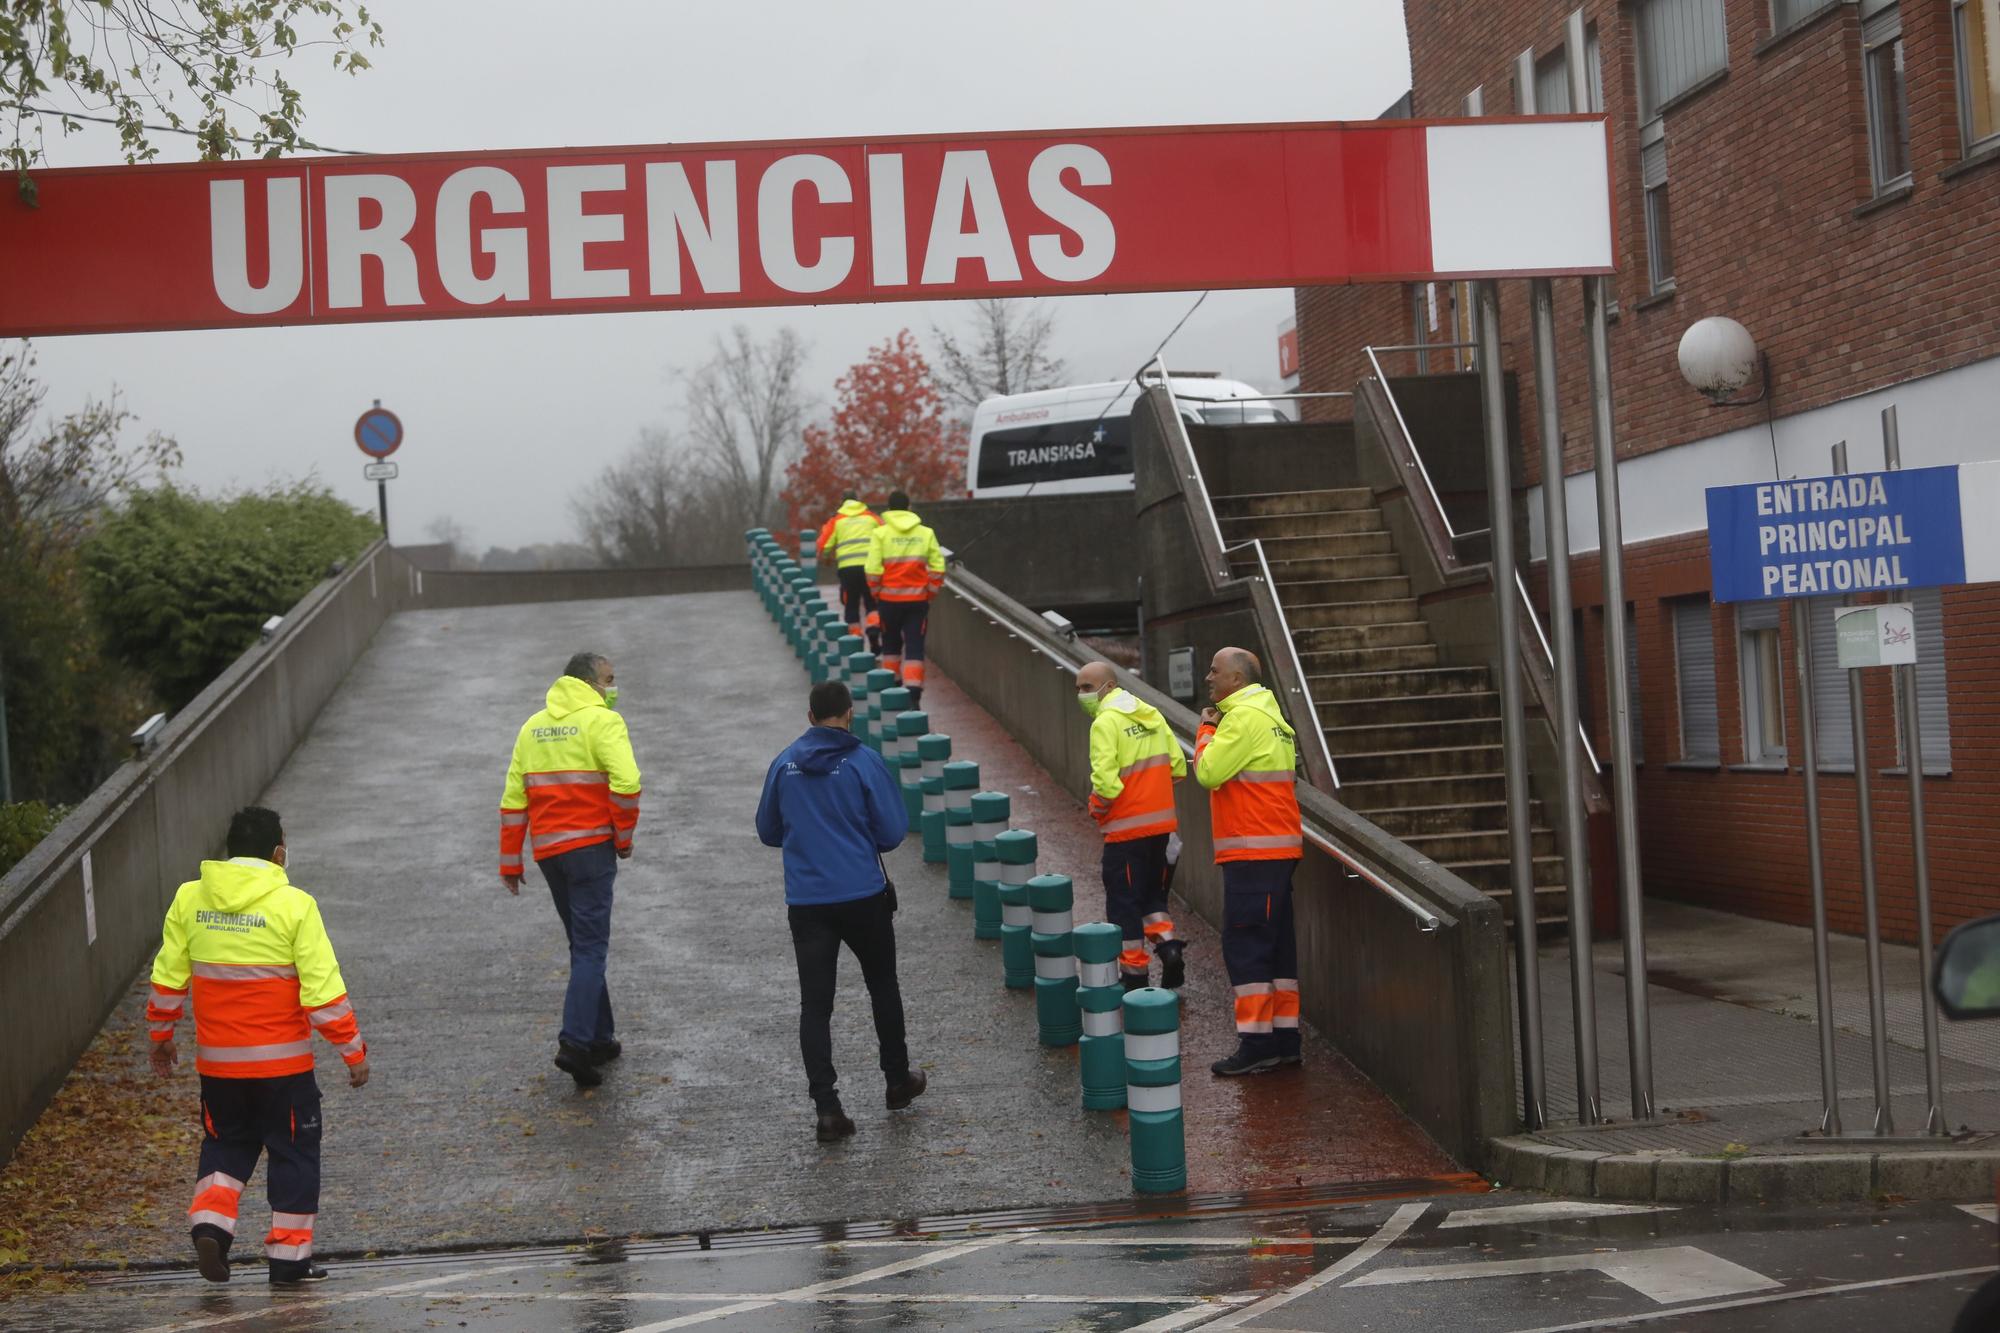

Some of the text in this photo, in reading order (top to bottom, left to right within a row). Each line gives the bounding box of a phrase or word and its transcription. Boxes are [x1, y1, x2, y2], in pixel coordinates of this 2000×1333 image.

[209, 143, 1117, 315] URGENCIAS
[996, 408, 1049, 423] Ambulancia
[1008, 442, 1096, 466] TRANSINSA
[1756, 476, 1887, 516] ENTRADA
[1759, 514, 1911, 556] PRINCIPAL
[1762, 555, 1909, 596] PEATONAL
[196, 911, 266, 928] ENFERMERÍA
[207, 925, 250, 933] AMBULANCIAS
